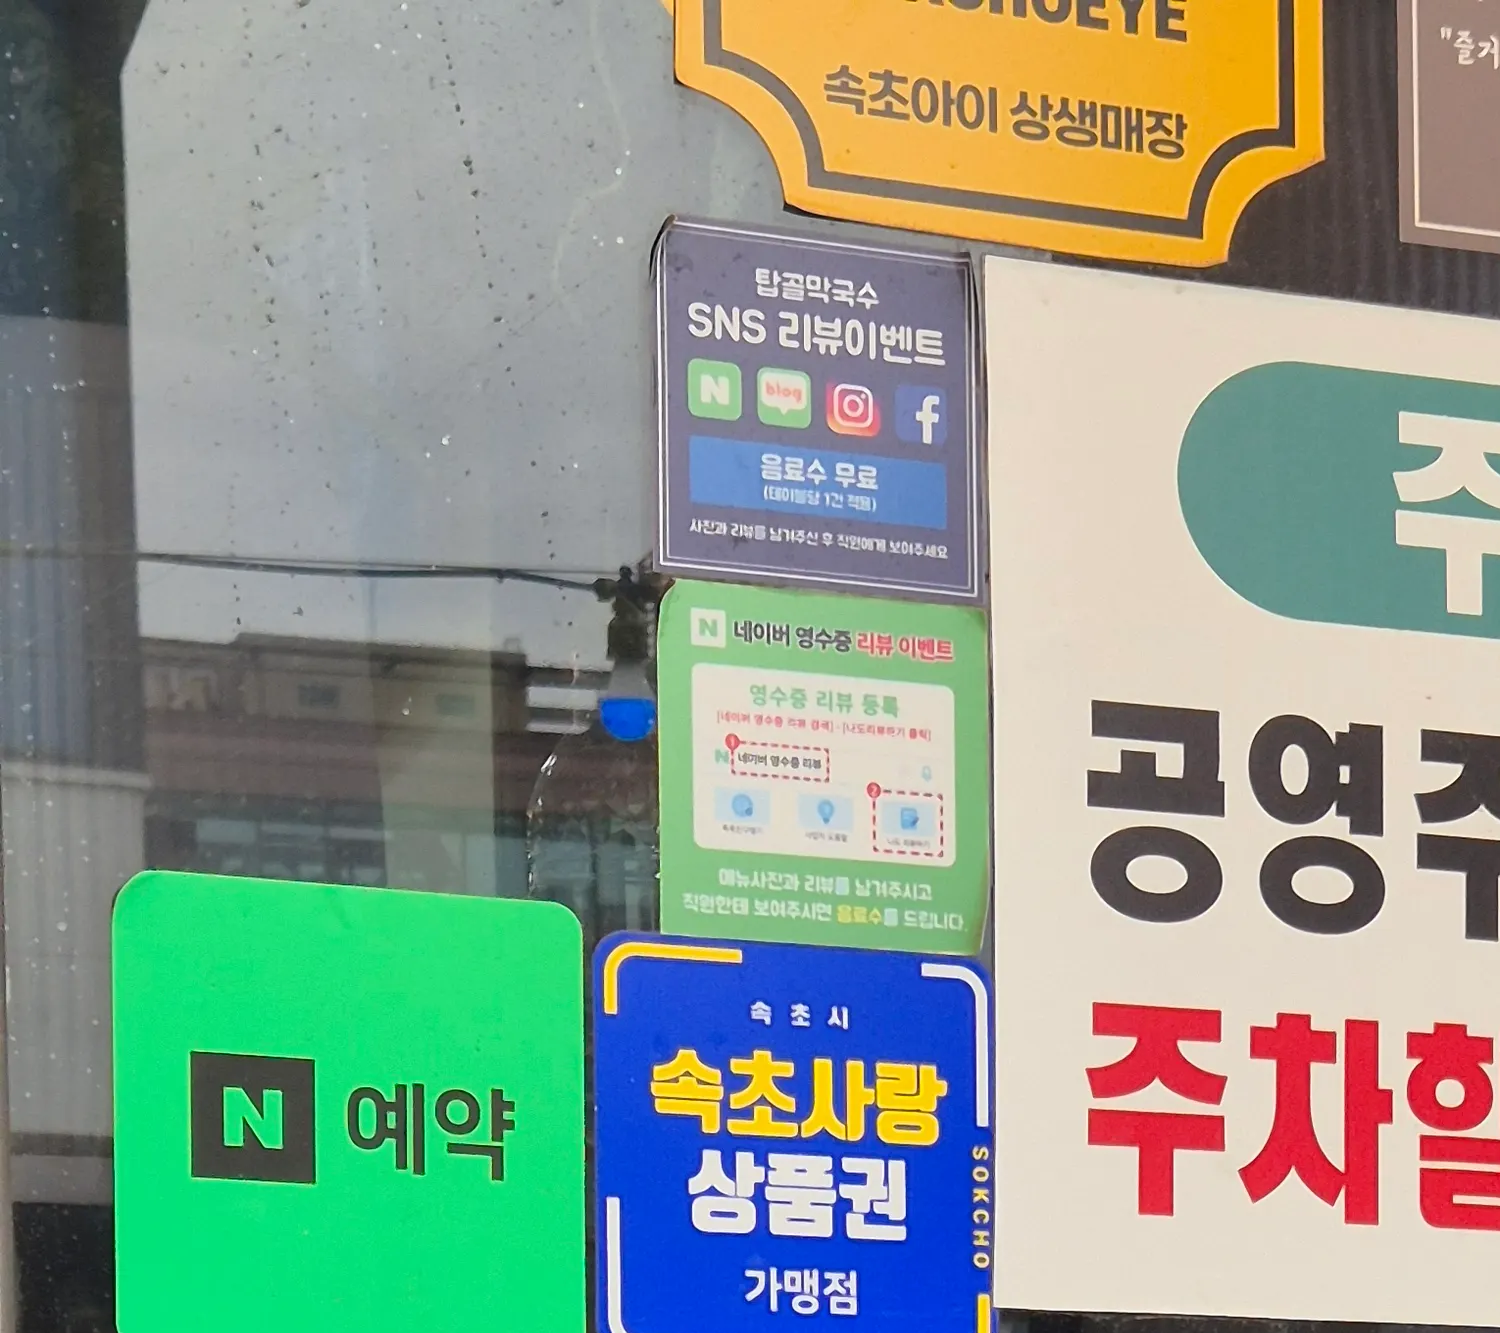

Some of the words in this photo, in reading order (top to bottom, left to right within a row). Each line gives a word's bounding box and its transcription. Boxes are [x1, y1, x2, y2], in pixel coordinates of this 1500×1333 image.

[824, 64, 998, 134] 속초아이
[1010, 91, 1188, 160] 상생매장
[755, 268, 879, 309] 탑골막국수
[688, 302, 767, 344] SNS
[778, 311, 946, 366] 리뷰이벤트
[700, 374, 730, 406] N
[765, 380, 803, 402] blog
[761, 453, 828, 485] 음료수
[834, 462, 879, 490] 무료
[689, 519, 728, 535] 사진과
[822, 534, 834, 547] 후
[698, 618, 718, 637] N
[733, 620, 791, 647] 네이버
[795, 626, 853, 653] 영수증
[856, 632, 893, 656] 리뷰
[898, 636, 954, 661] 이벤트
[750, 684, 807, 709] 영수증
[816, 690, 853, 714] 리뷰
[861, 695, 899, 718] 등록
[651, 1049, 948, 1145] 속초사랑
[223, 1087, 282, 1150] N
[347, 1085, 516, 1182] 예약
[688, 1149, 907, 1241] 상품권
[972, 1146, 990, 1269] SOKCHO
[744, 1266, 858, 1315] 가맹점
